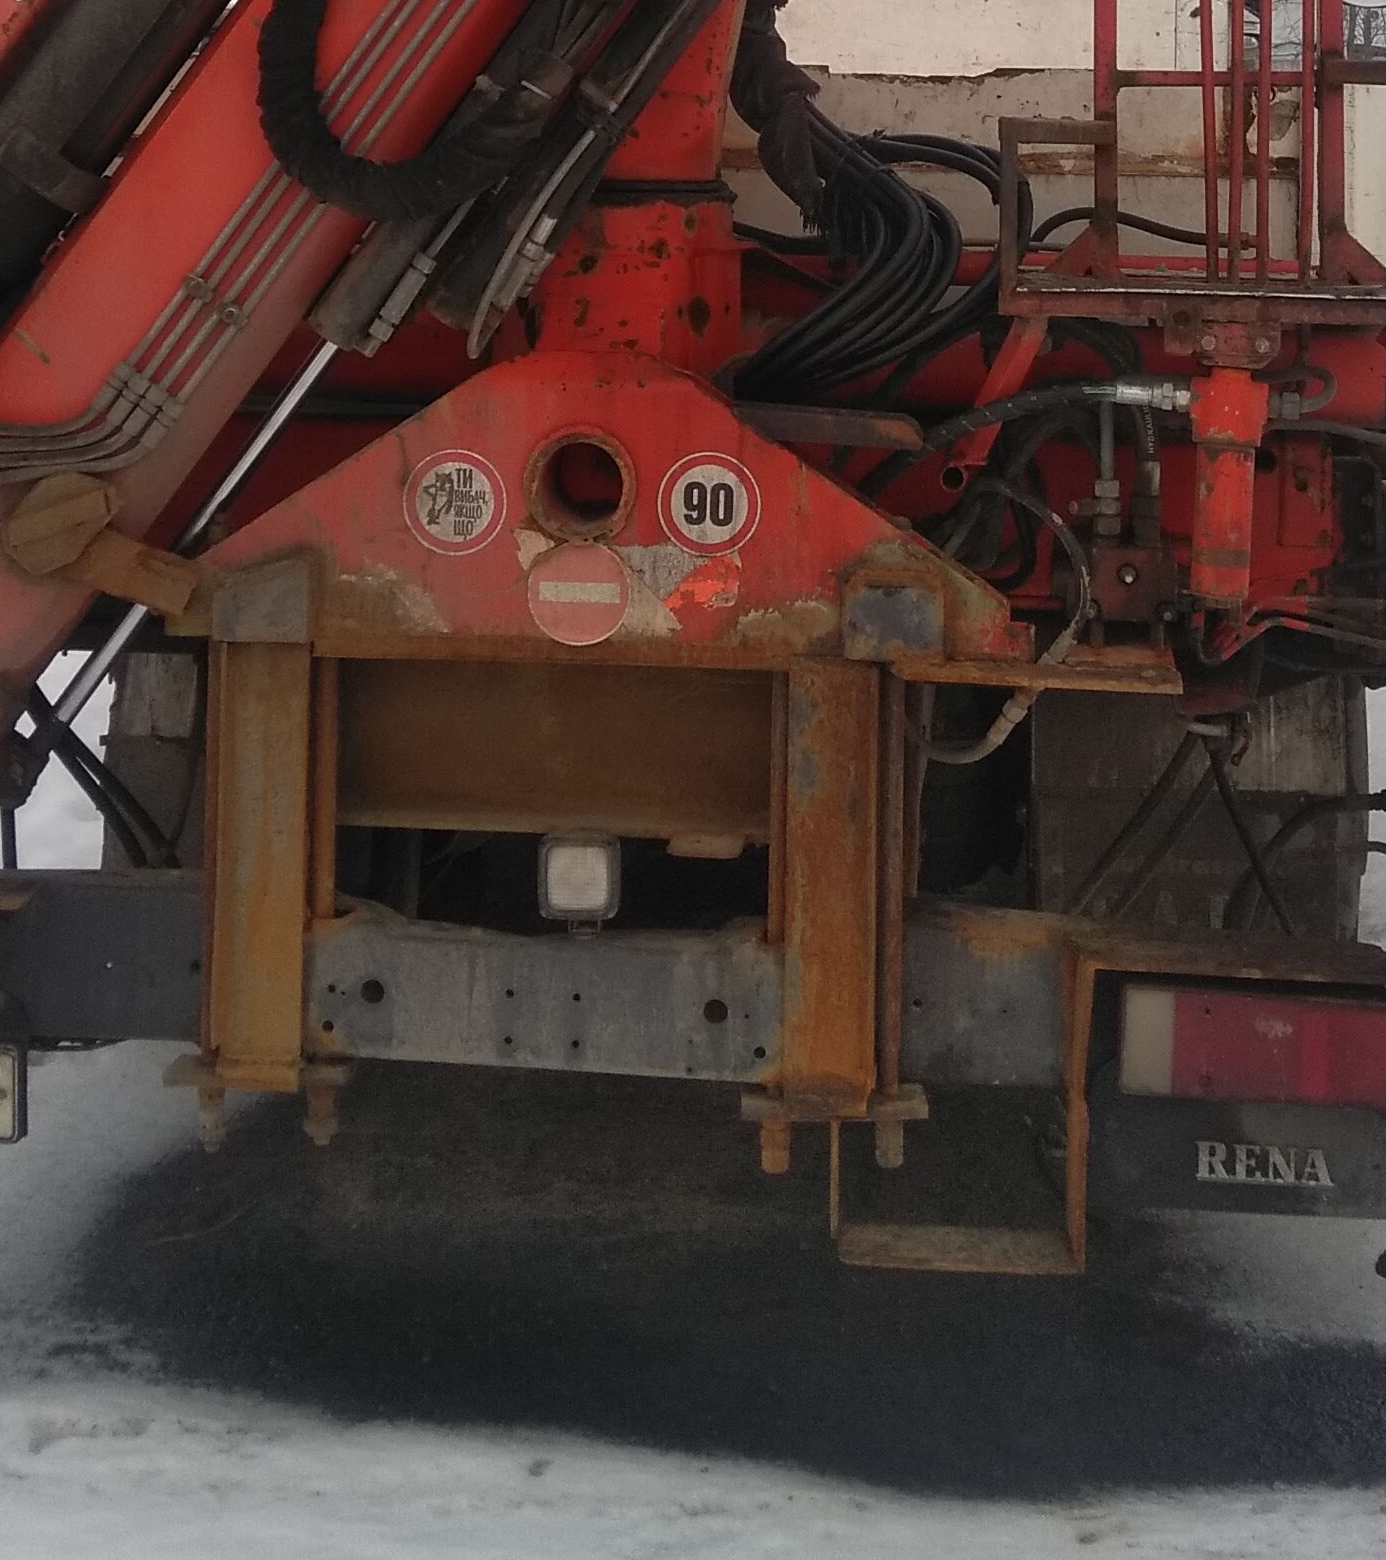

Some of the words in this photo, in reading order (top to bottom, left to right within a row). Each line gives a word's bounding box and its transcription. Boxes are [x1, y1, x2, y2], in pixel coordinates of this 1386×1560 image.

[454, 468, 473, 489] ТИ
[454, 489, 489, 505] ВИБАЧ,
[684, 481, 734, 527] 90
[453, 504, 483, 523] ЯКЩО
[453, 519, 474, 540] ЩО
[1195, 1140, 1335, 1187] RENA
